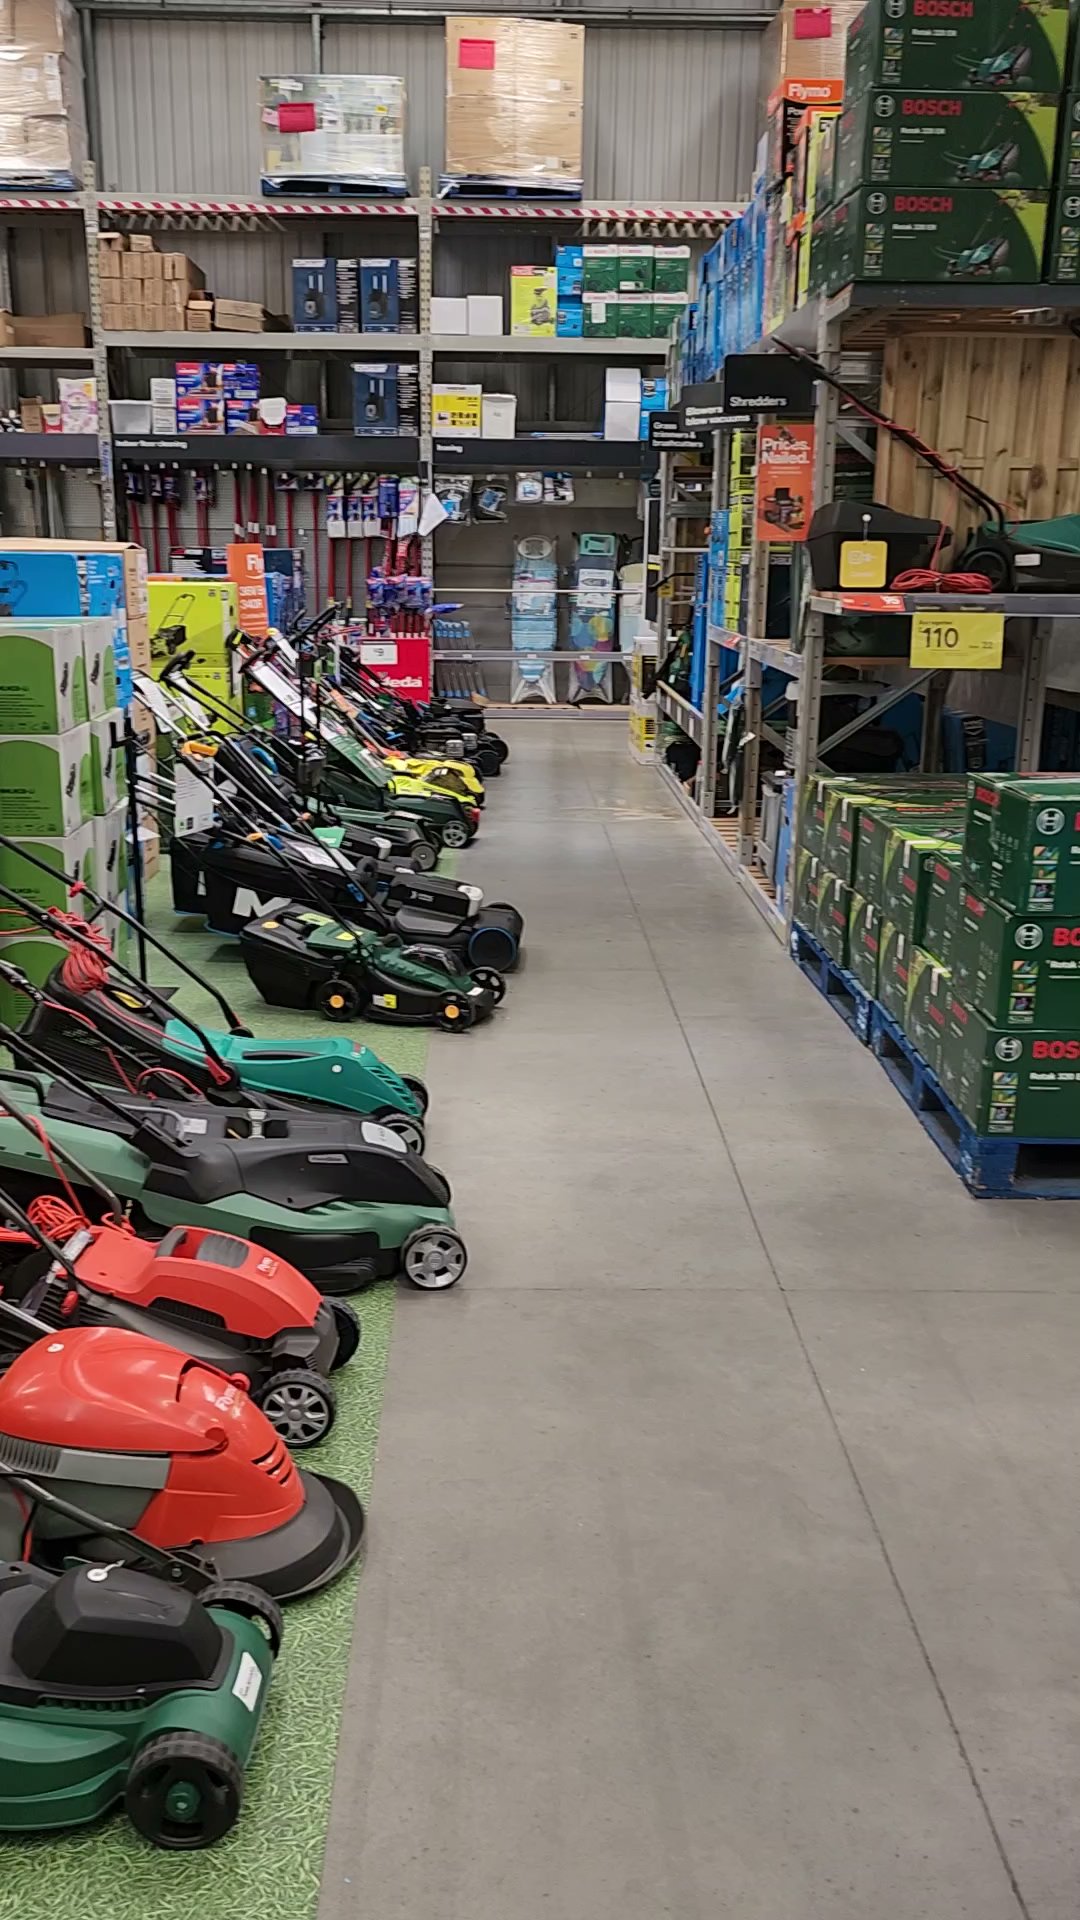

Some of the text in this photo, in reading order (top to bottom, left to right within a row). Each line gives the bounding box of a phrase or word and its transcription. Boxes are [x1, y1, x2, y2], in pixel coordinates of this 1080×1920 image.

[913, 0, 974, 17] BOSCH
[788, 83, 831, 100] Flymo
[902, 100, 962, 116] BOSCH
[893, 196, 953, 213] BOSCH
[729, 396, 788, 407] Shredders
